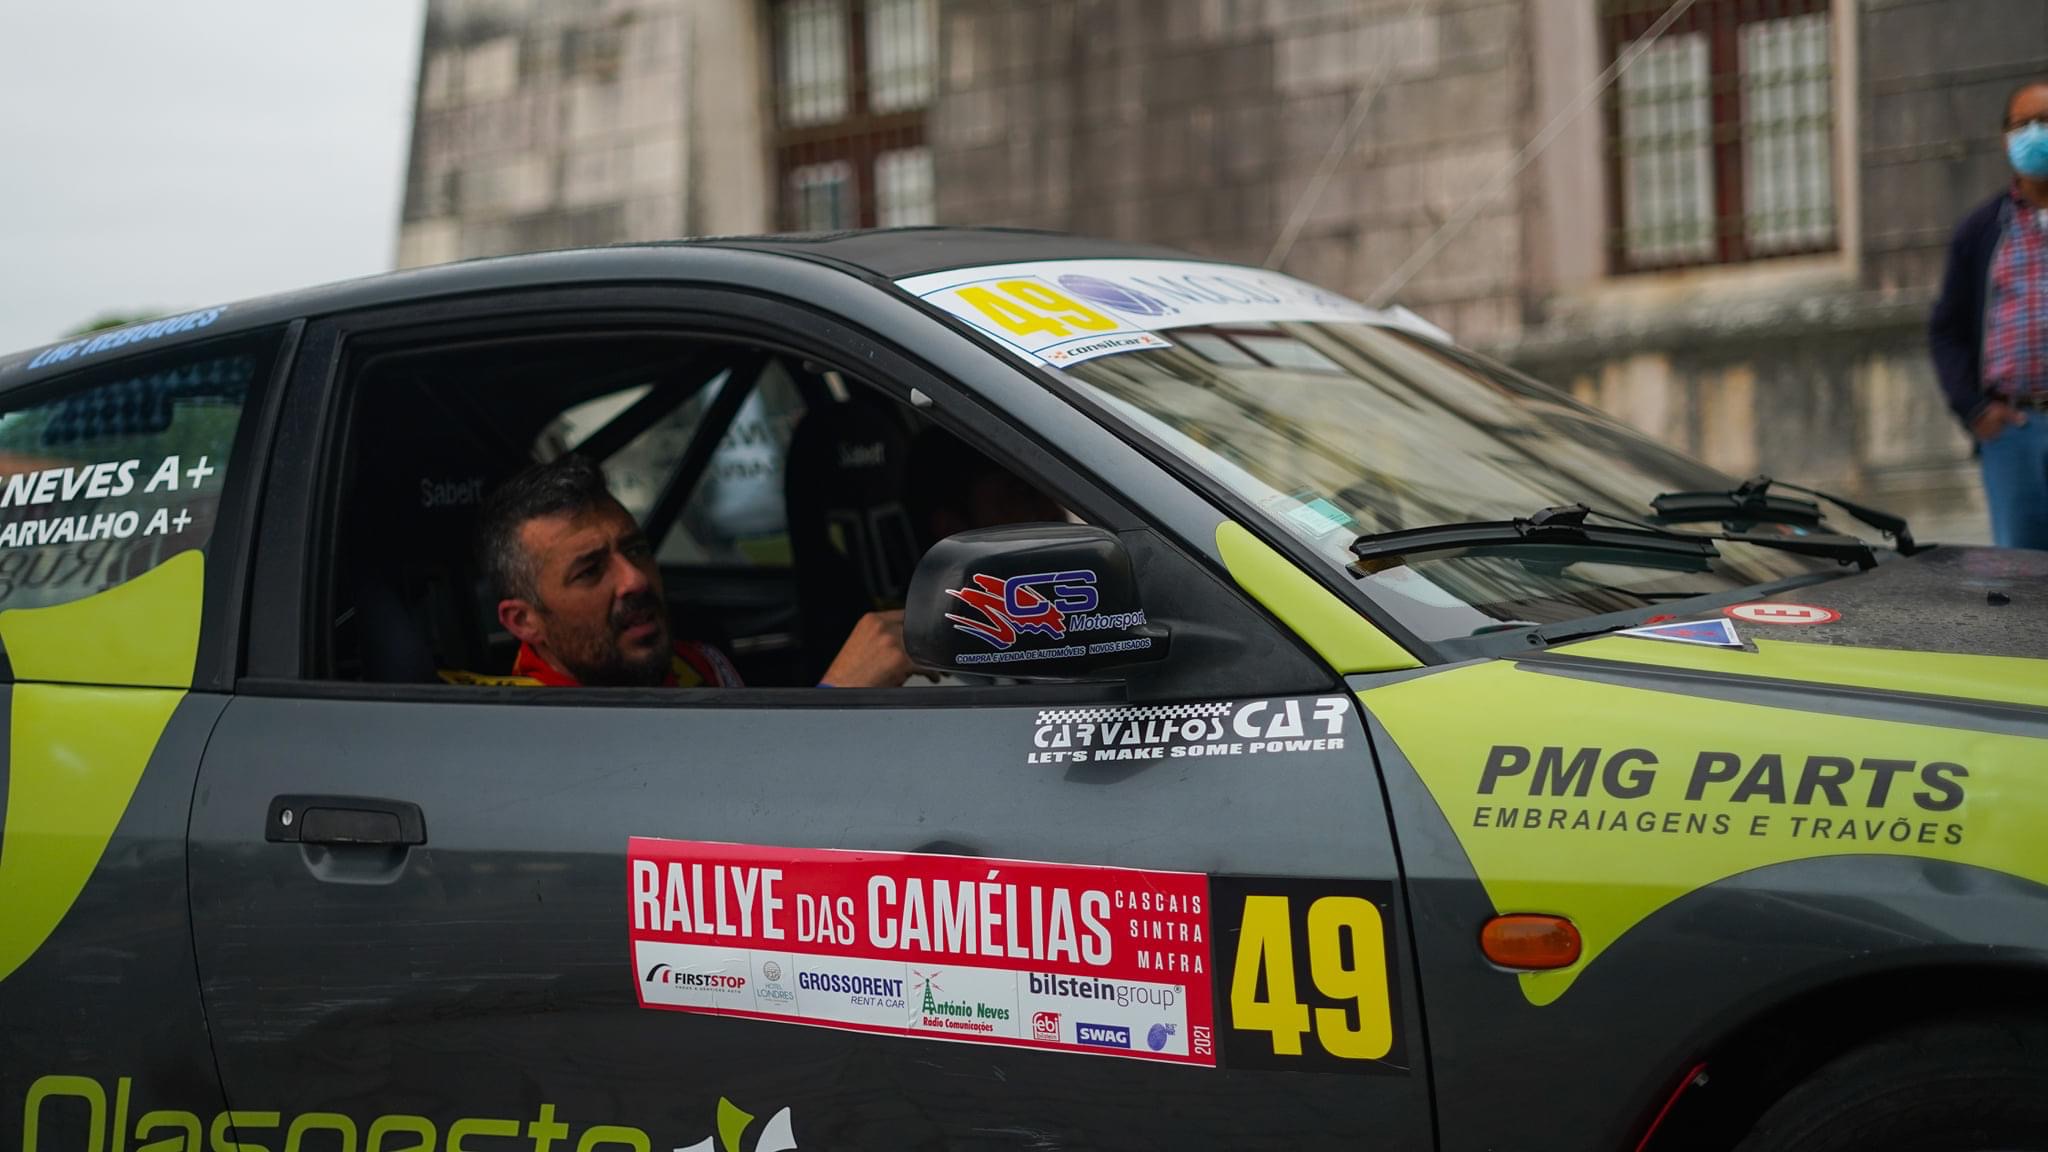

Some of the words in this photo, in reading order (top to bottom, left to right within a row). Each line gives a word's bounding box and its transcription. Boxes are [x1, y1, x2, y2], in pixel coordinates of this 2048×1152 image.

[954, 280, 1119, 338] 49
[0, 459, 140, 508] NEVES
[144, 455, 214, 493] A+
[0, 510, 139, 548] ARVALHO
[143, 508, 192, 536] A+
[1004, 569, 1099, 618] CS
[955, 654, 991, 664] COMPRA
[993, 653, 999, 662] E
[1000, 651, 1024, 662] VENDA
[1026, 650, 1038, 660] DE
[1039, 645, 1086, 659] AUTOMÓVEIS
[1089, 643, 1115, 654] NOVOS
[1116, 641, 1121, 651] E
[1122, 638, 1152, 650] USADOS
[1233, 698, 1349, 738] CAR
[1028, 750, 1088, 763] LET'S
[1094, 747, 1164, 761] MAKE
[1171, 743, 1242, 758] SOME
[1249, 738, 1345, 754] POWER
[1477, 745, 1660, 799] PMG
[1685, 751, 1970, 812] PARTS
[1473, 807, 1731, 835] EMBRAIAGENS
[1750, 816, 1769, 836] E
[1791, 817, 1964, 845] TRAVÕES
[633, 860, 785, 940] RALLYE
[796, 893, 855, 946] DAS
[867, 870, 1112, 967] CAMÉLIAS
[1115, 889, 1202, 915] CASCAIS
[1130, 919, 1202, 943] SINTRA
[1138, 950, 1203, 974] MAFRA
[675, 973, 746, 989] FIRSTSTOP
[799, 972, 903, 998] GROSSORENT
[1231, 896, 1392, 1060] 49
[851, 996, 875, 1006] RENT
[877, 998, 884, 1007] A
[886, 999, 904, 1008] CAR
[922, 993, 972, 1016] António
[977, 1003, 1010, 1020] Neves
[1080, 1028, 1127, 1044] SWAG
[1194, 1025, 1211, 1055] 2021
